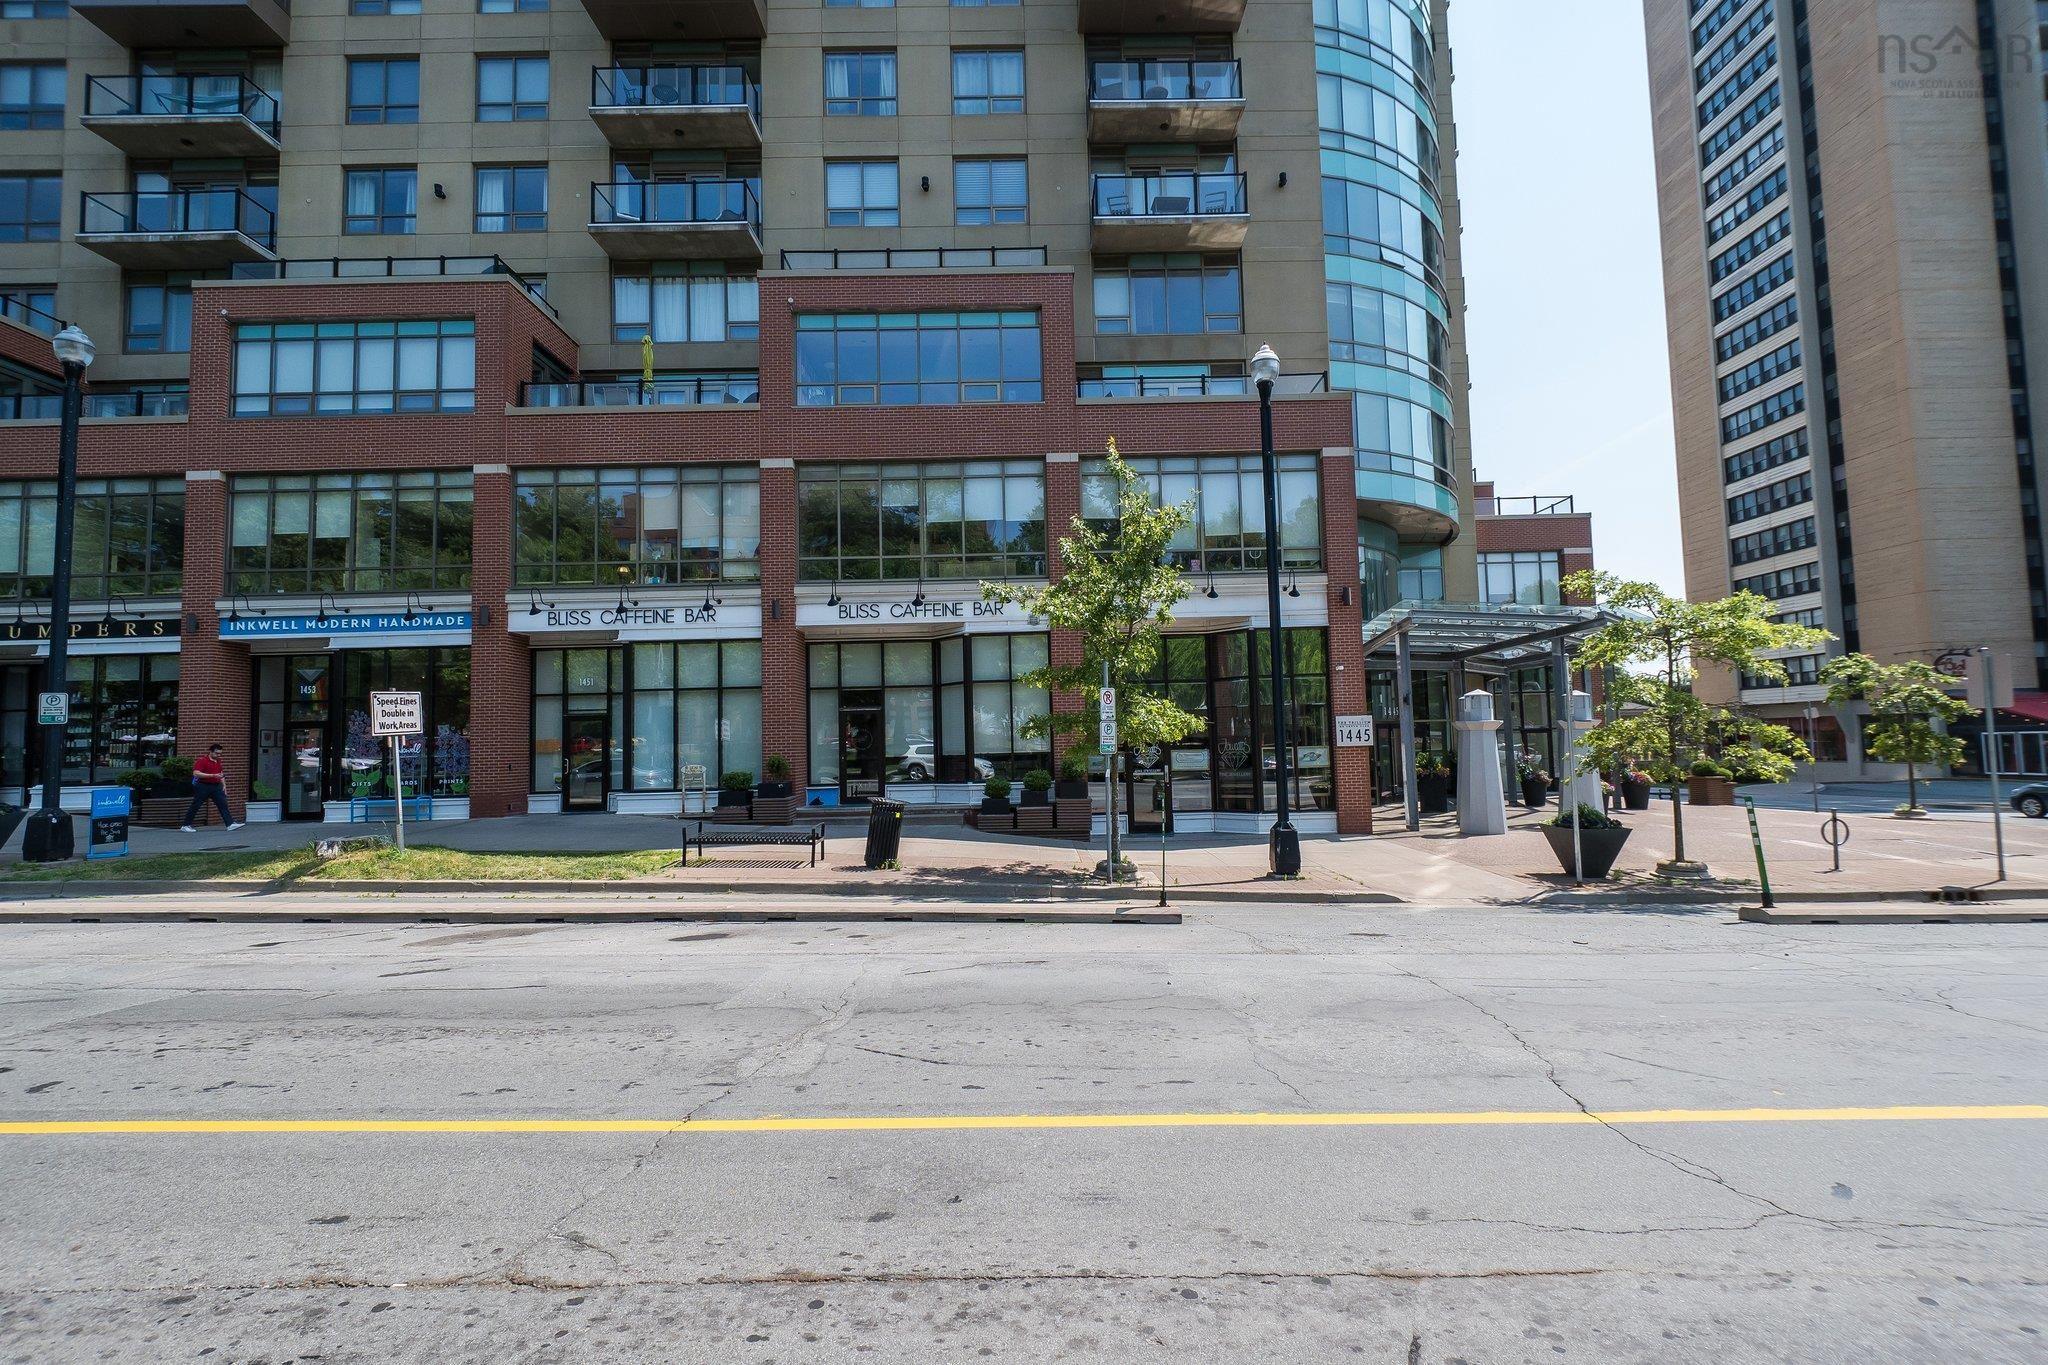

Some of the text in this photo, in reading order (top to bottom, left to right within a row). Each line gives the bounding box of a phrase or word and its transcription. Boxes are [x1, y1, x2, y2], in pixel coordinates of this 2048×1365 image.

[839, 601, 1004, 619] BLISS CAFFEINE BAR
[547, 608, 717, 626] BLISS CAFFEINE BAR
[230, 616, 464, 631] INKWELL MODERN HANDMADE
[579, 677, 594, 686] 1451
[300, 685, 316, 694] 1453
[376, 697, 399, 708] Speed
[381, 709, 414, 718] Double in
[378, 721, 418, 730] Work Areas
[1339, 728, 1371, 743] 1445
